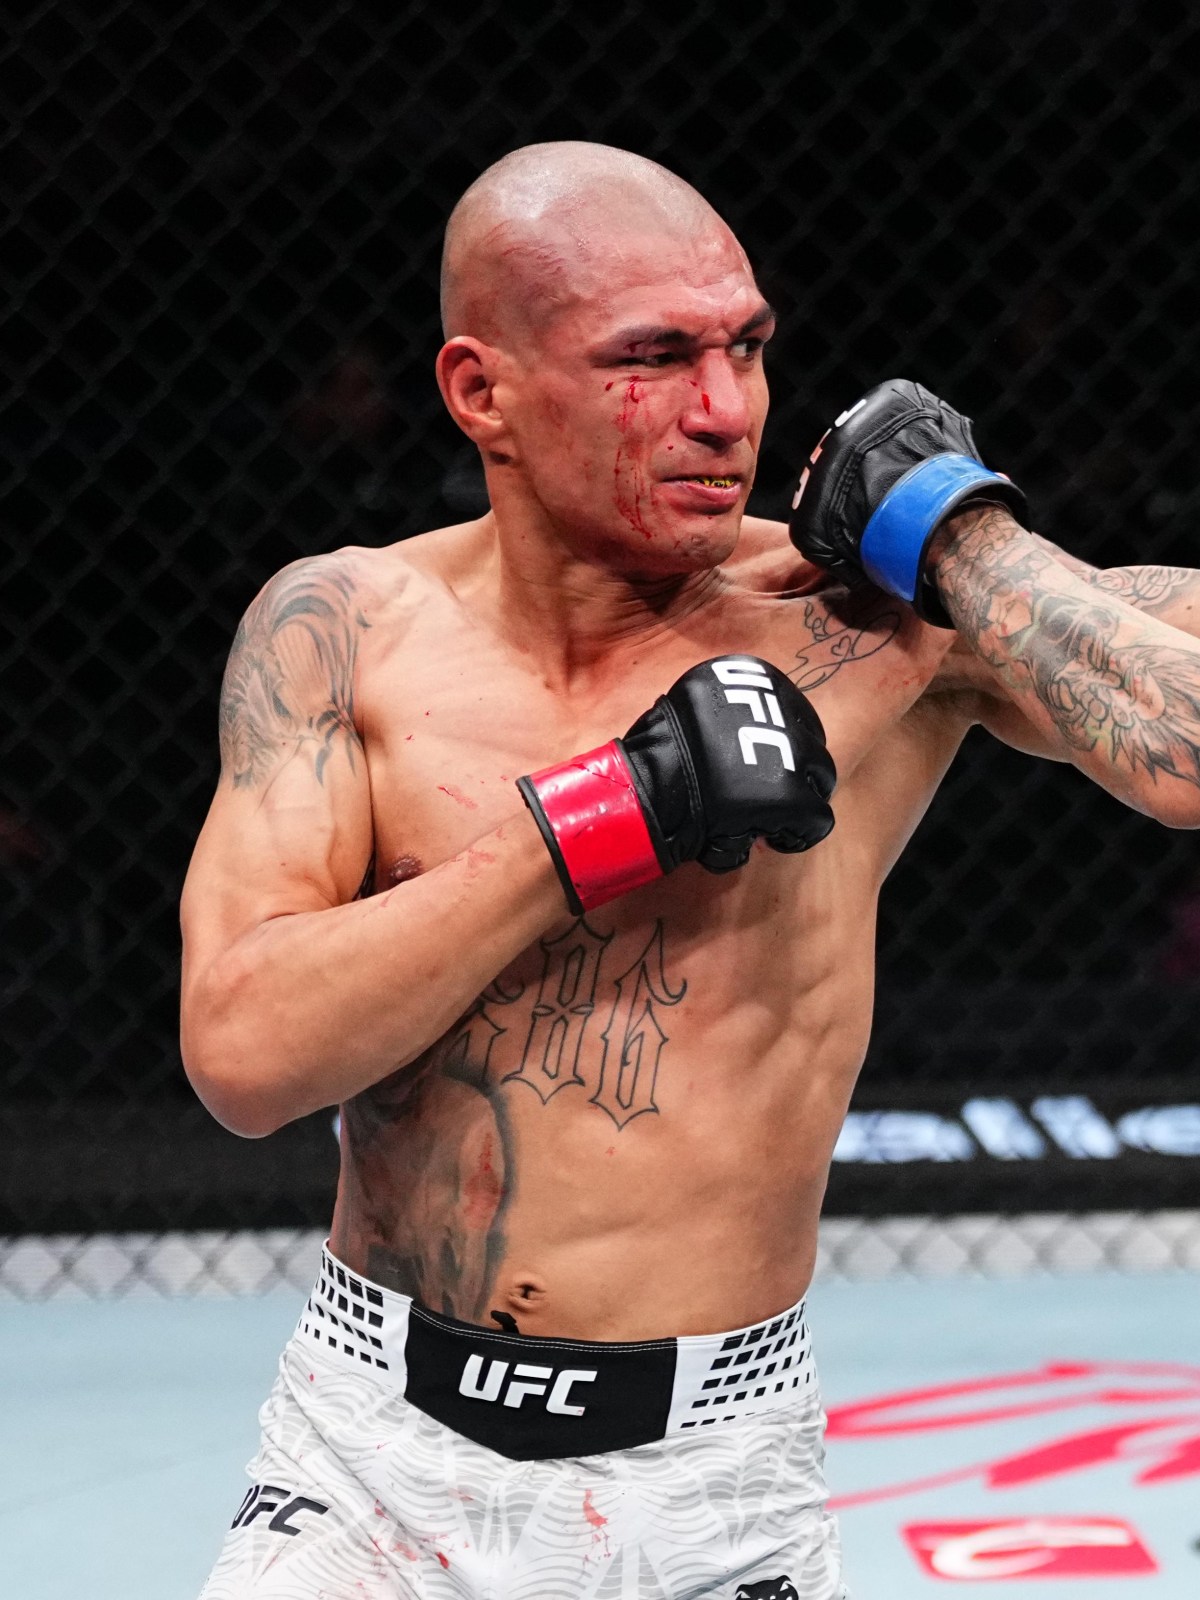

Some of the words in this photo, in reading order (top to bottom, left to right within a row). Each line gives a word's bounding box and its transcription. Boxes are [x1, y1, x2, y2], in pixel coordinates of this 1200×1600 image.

[711, 661, 795, 772] UFC
[458, 1354, 597, 1416] UFC
[231, 1484, 329, 1536] UFC
